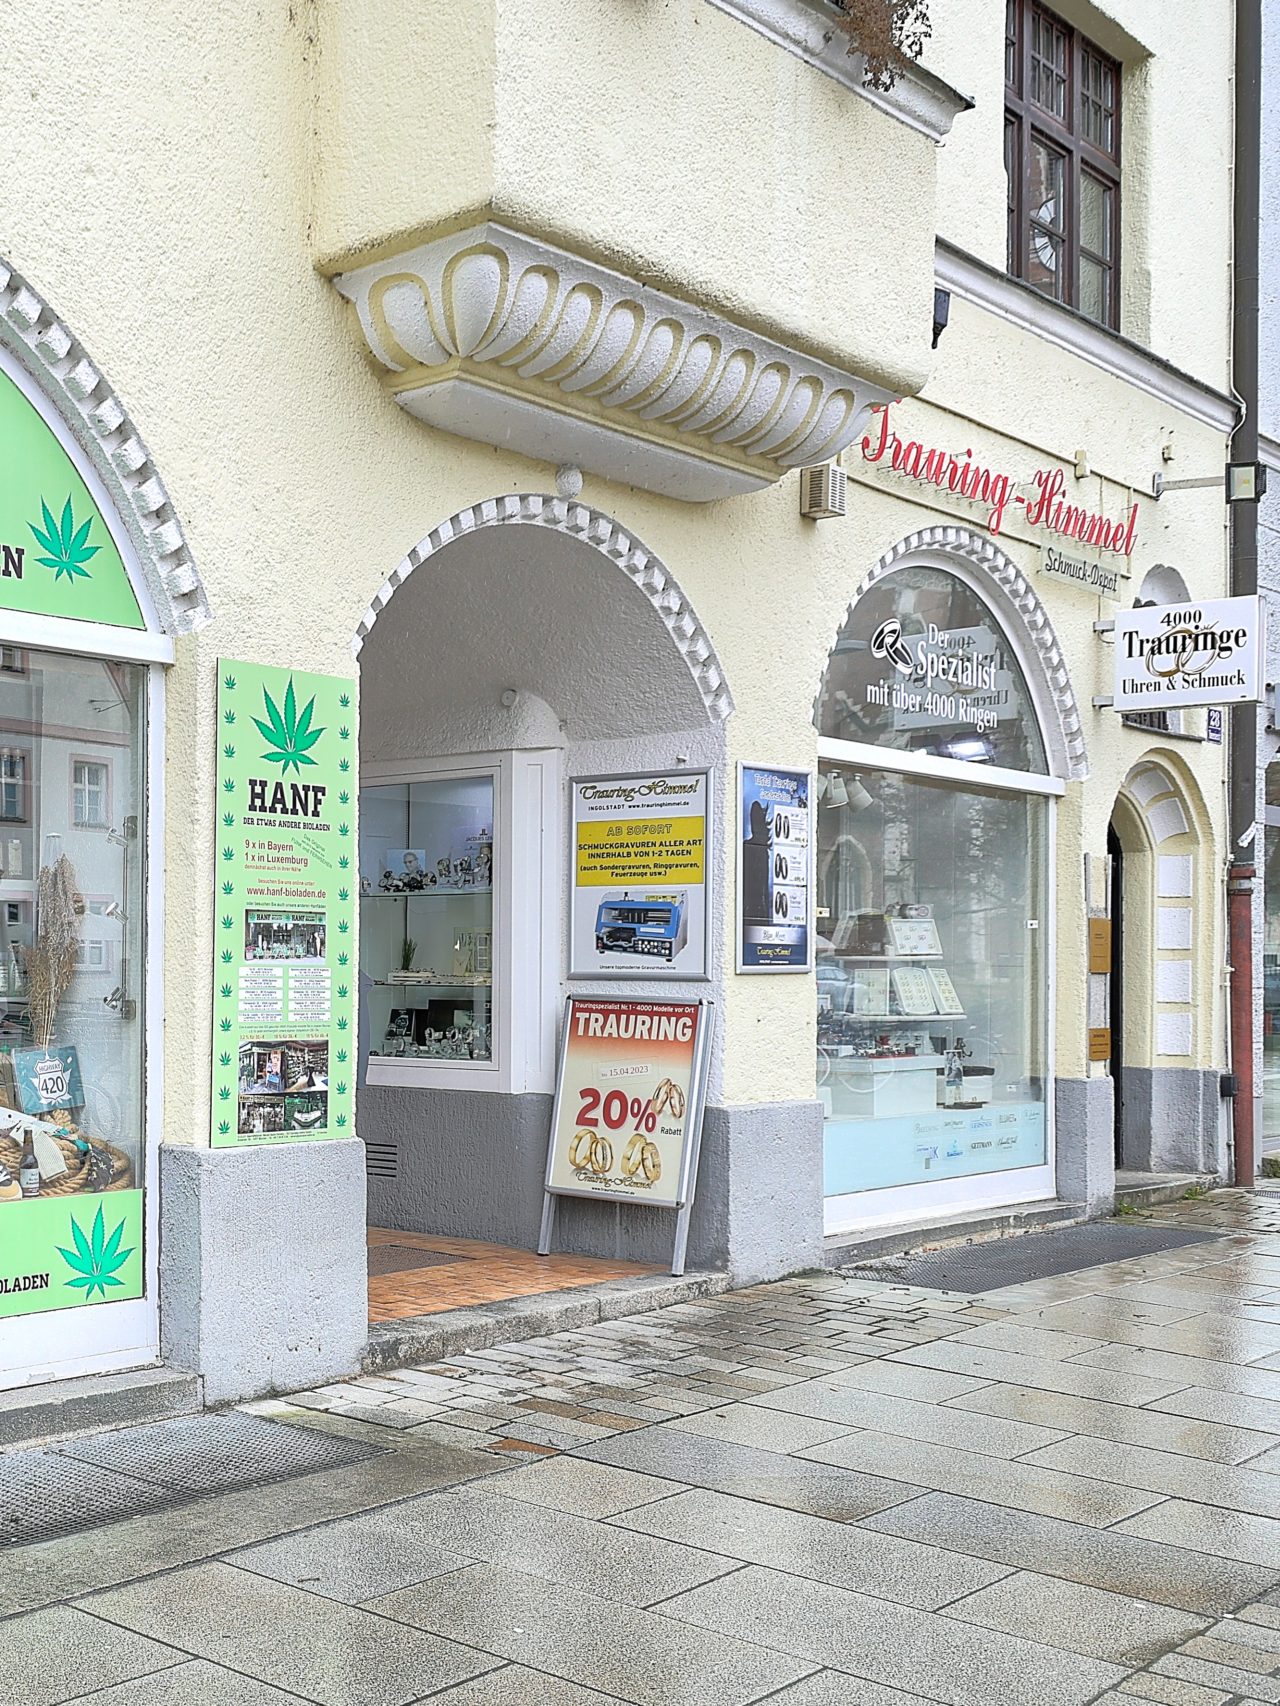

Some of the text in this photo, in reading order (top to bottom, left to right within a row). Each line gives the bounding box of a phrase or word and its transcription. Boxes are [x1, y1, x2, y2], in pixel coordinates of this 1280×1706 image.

[1044, 547, 1117, 593] Schmuck-Depot
[1160, 609, 1202, 627] 4000
[928, 623, 950, 648] Der
[1123, 626, 1247, 660] Trauringe
[917, 640, 996, 692] Spezialist
[1122, 668, 1246, 695] Uhren & Schmuck
[866, 678, 998, 733] mit über 4000 Ringen
[247, 778, 327, 818] HANF
[579, 778, 701, 802] Trauring-Himmel
[588, 800, 690, 811] INGOLSTADT www.trauringhimmel.de
[243, 816, 331, 832] DER ETWAS ANDERE BIOLADEN
[606, 823, 673, 837] AB SOFORT
[244, 839, 251, 849] 9
[258, 839, 266, 850] in
[267, 840, 294, 853] Bayern
[578, 838, 703, 851] SCHMUCKGRAVUREN ALLER ART
[244, 851, 249, 862] 1
[257, 852, 265, 862] in
[266, 853, 309, 868] Luxemburg
[587, 848, 692, 860] INNERHALB VON 1-2 TAGEN
[580, 861, 700, 872] (auch Sondergravuren, Ringgravuren,
[610, 869, 668, 878] Feuerzeuge usw.)
[246, 886, 327, 899] www.hanf-bioladen.de
[615, 963, 641, 971] topmoderne
[575, 1001, 620, 1011] Trauringspezialist
[636, 1004, 652, 1012] 4000
[653, 1005, 674, 1013] Modelle
[684, 1006, 695, 1014] Ort
[575, 1012, 693, 1042] TRAURING
[39, 1062, 62, 1073] HIGHWAY
[609, 1065, 649, 1077] 15.04.2023
[40, 1076, 65, 1096] 420
[575, 1087, 657, 1133] 20%
[660, 1126, 682, 1136] Rabatt
[575, 1171, 654, 1190] Trauring-Himmel
